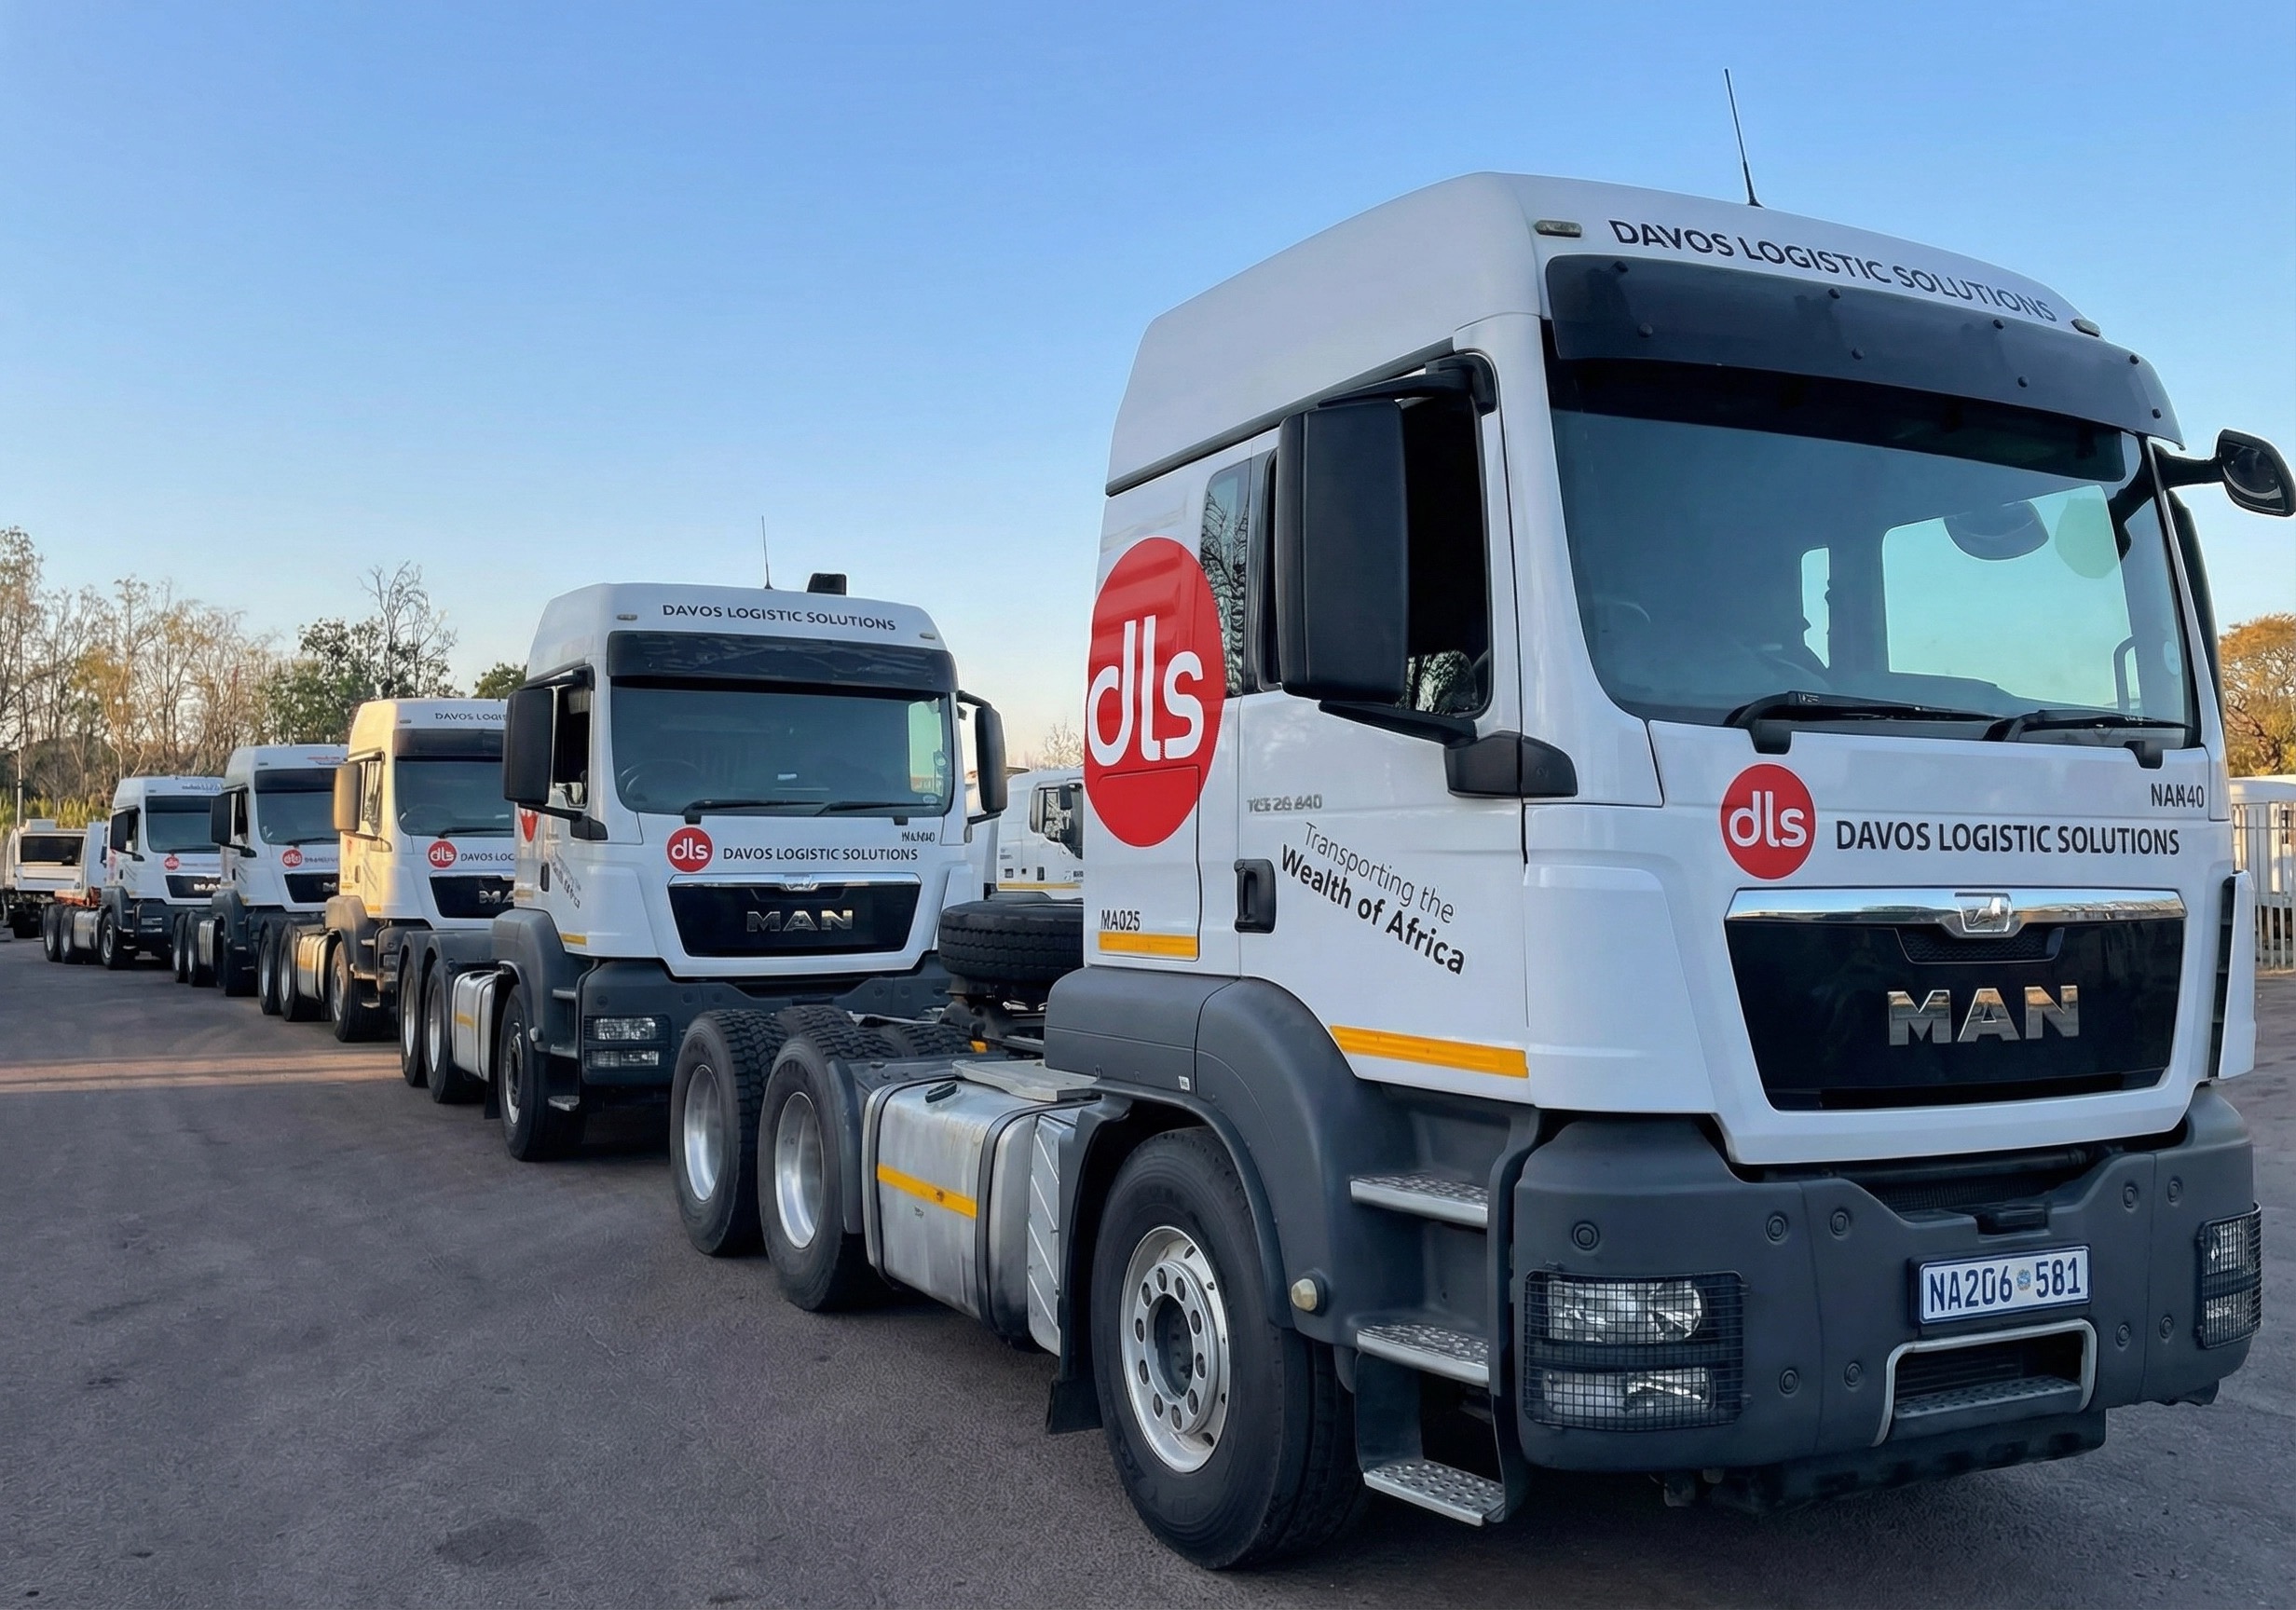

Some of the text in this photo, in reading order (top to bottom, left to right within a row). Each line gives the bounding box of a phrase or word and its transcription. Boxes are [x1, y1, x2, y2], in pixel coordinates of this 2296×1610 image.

[1607, 219, 2058, 323] DAVOS LOGISTIC SOLUTIONS
[663, 604, 896, 631] DAVOS LOGISTIC SOLUTIONS
[1086, 614, 1205, 767] dls
[434, 712, 473, 721] DAVOS
[1729, 790, 1806, 849] dls
[671, 837, 708, 860] dls
[723, 848, 919, 861] DAVOS LOGISTIC SOLUTIONS
[1836, 820, 2180, 856] DAVOS LOGISTIC SOLUTIONS
[460, 853, 493, 862] DAVOS
[1305, 822, 1455, 923] Transporting the
[746, 909, 854, 933] MAN
[1100, 909, 1141, 932] MA025
[1281, 843, 1466, 976] Wealth of Africa
[1886, 984, 2080, 1046] MAN
[1929, 1257, 2082, 1313] NA206 581
